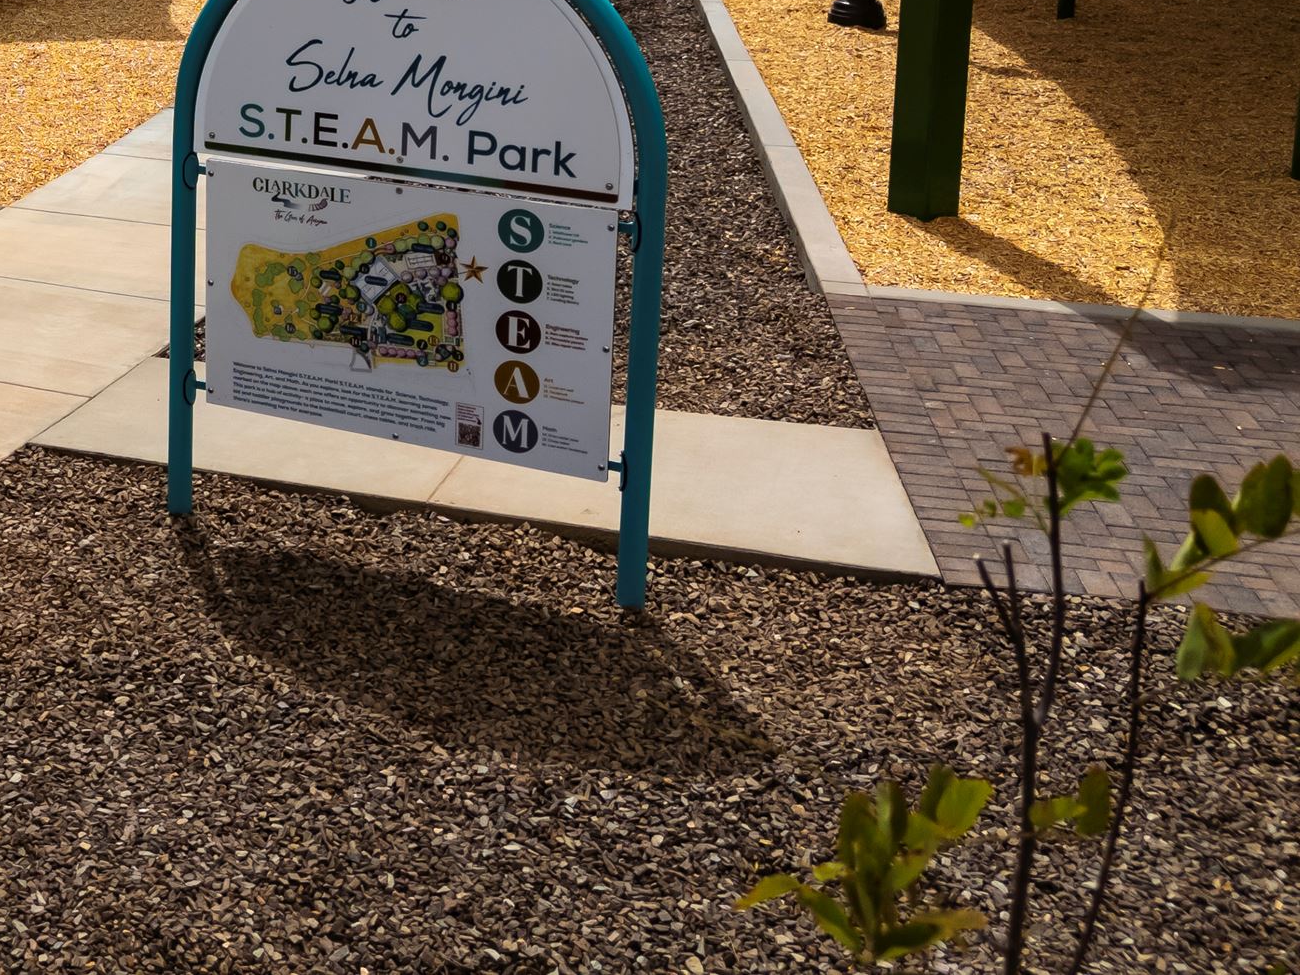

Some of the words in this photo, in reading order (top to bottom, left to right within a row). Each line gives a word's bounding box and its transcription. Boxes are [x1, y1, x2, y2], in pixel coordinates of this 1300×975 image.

[384, 8, 428, 38] to
[285, 38, 384, 93] Selna
[390, 53, 529, 126] Mongini
[238, 103, 449, 162] S.T.E.A.M.
[467, 129, 577, 178] Park
[252, 177, 351, 204] CLARKDALE
[510, 215, 532, 247] S
[507, 265, 533, 298] T
[507, 315, 531, 349] E
[503, 366, 532, 399] A
[502, 414, 529, 449] M
